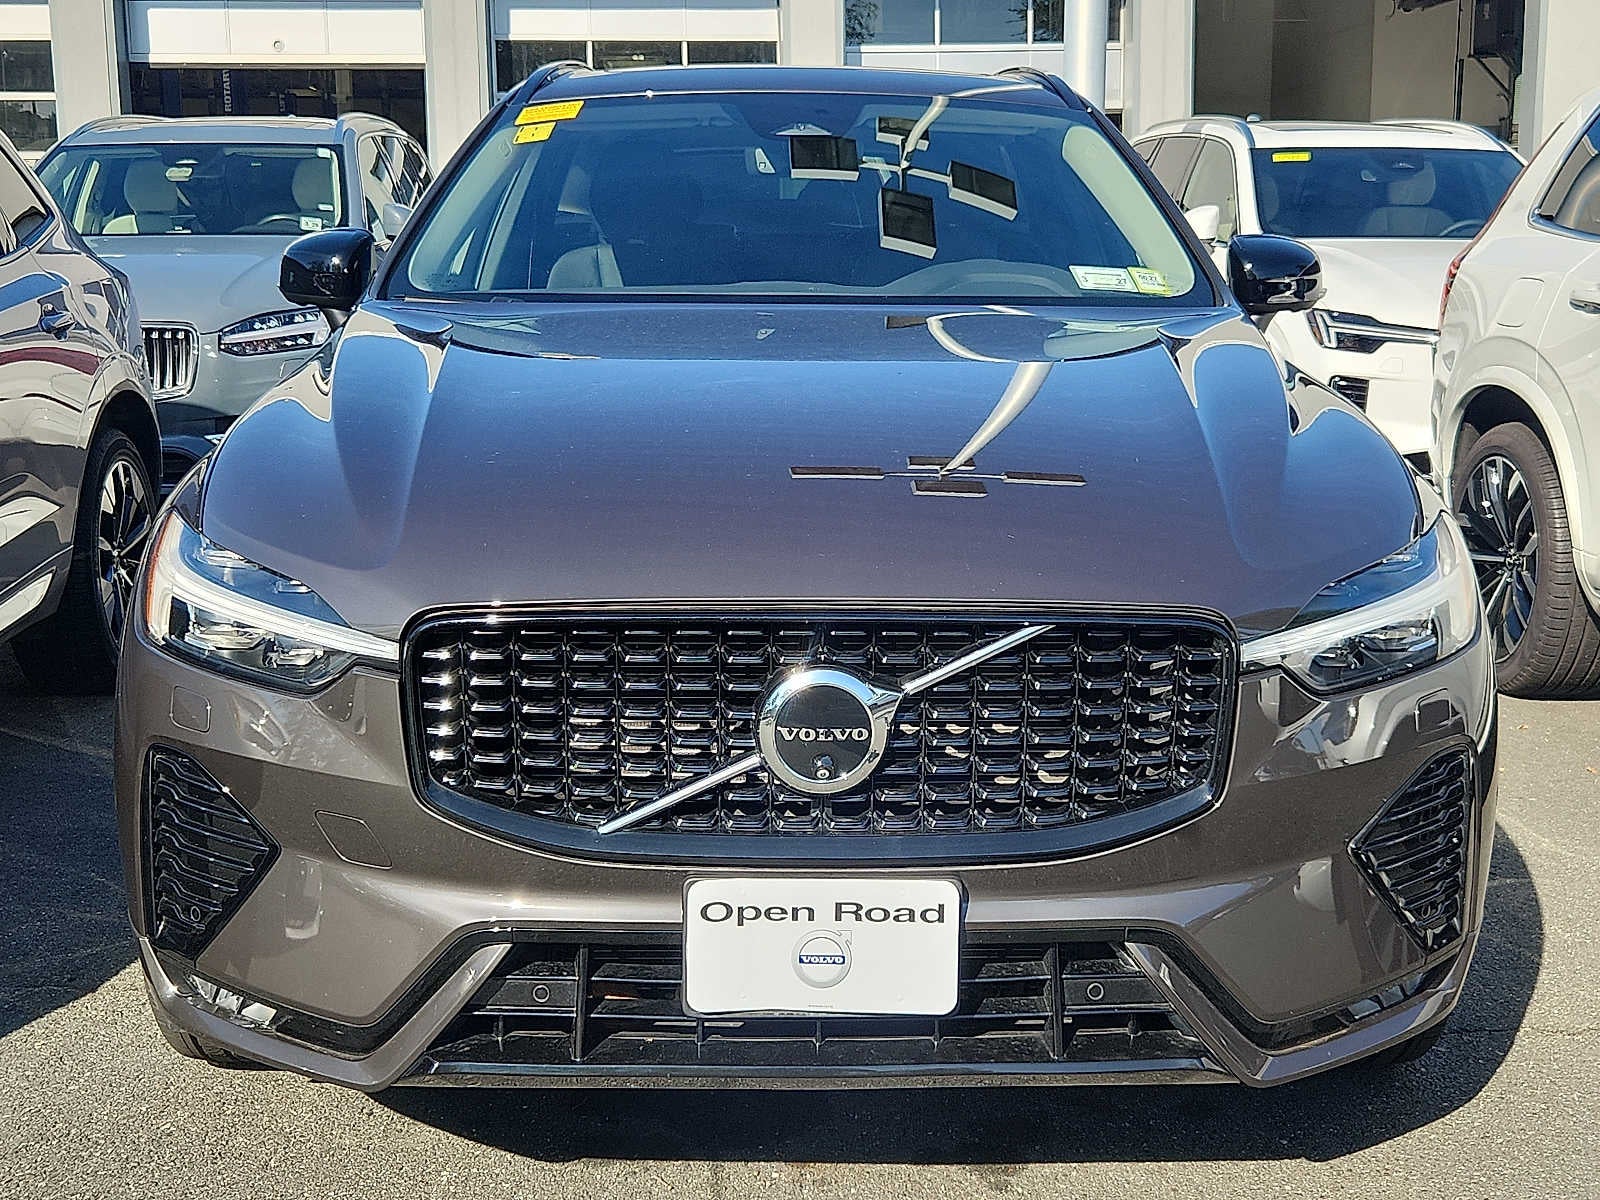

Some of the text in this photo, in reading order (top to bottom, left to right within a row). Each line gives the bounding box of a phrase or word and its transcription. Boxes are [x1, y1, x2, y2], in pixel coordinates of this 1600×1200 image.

[776, 725, 870, 742] VOLVO
[700, 901, 945, 927] Open Road
[800, 955, 844, 964] VOLVO
